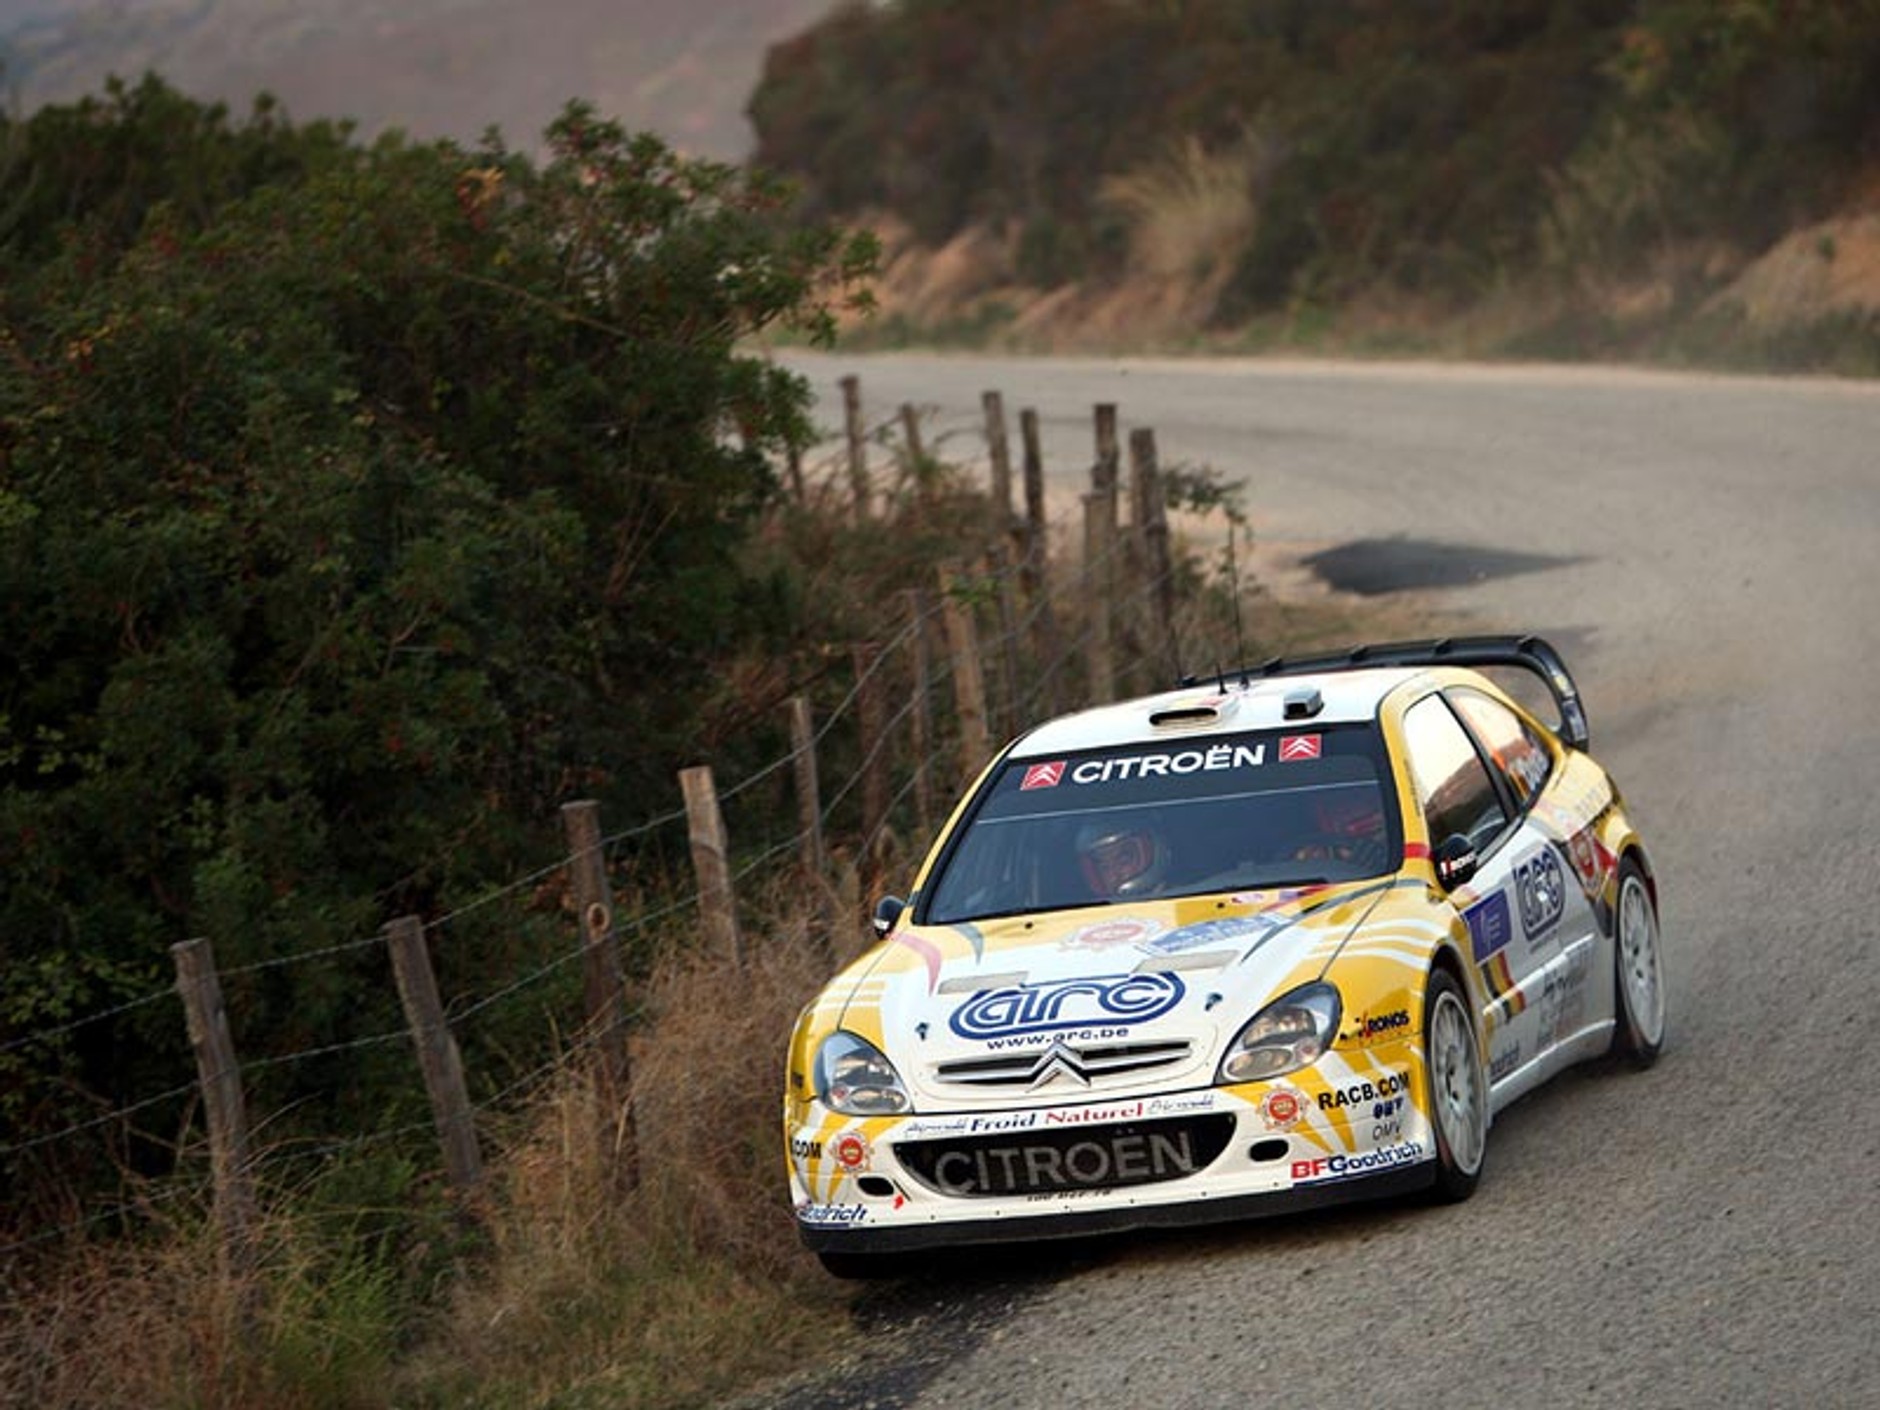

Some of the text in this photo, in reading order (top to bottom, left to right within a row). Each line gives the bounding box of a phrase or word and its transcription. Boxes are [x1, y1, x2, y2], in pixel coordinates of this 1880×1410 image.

[1071, 744, 1266, 785] CITROËN
[1317, 1072, 1411, 1111] RACB.COM
[970, 1113, 1037, 1133] Froid
[1044, 1103, 1144, 1125] Naturel
[934, 1129, 1195, 1195] CITROËN
[1290, 1141, 1424, 1180] BFGoodrich
